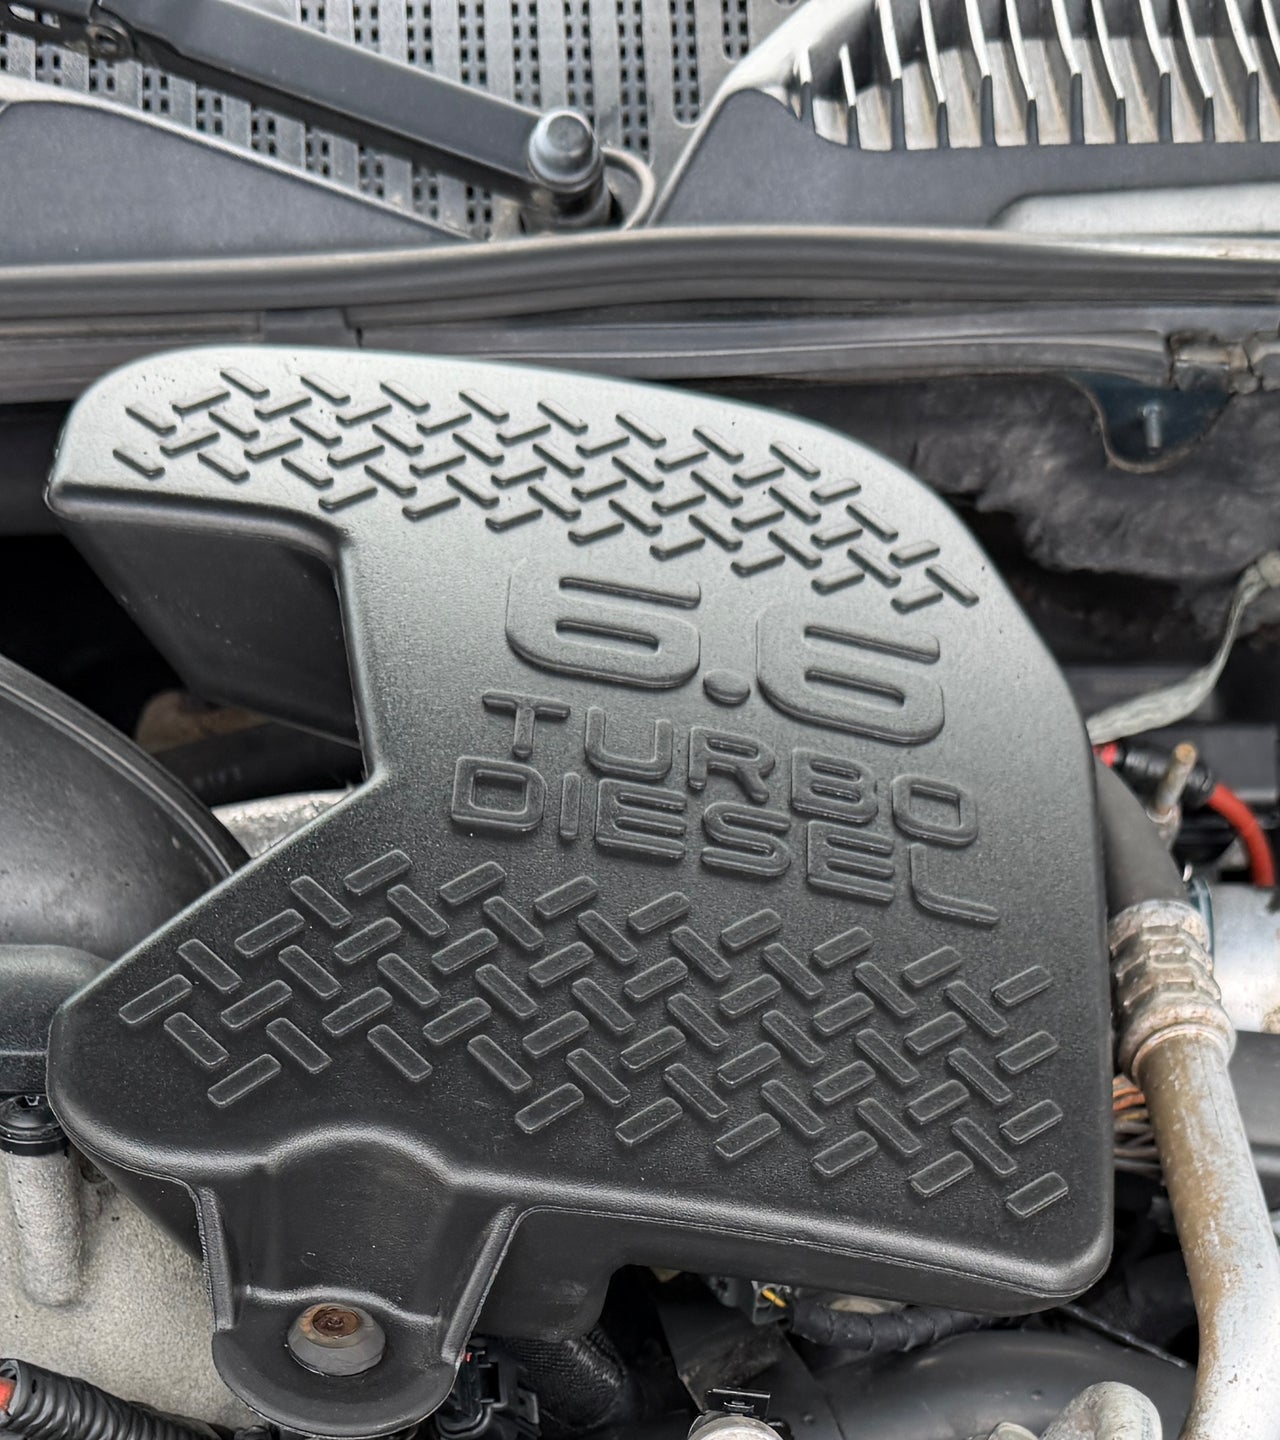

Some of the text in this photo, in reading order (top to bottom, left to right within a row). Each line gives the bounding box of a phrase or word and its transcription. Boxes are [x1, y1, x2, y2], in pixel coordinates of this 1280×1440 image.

[505, 557, 945, 745] 6.6
[450, 755, 1000, 926] DIESEL
[482, 689, 979, 847] TURBO
